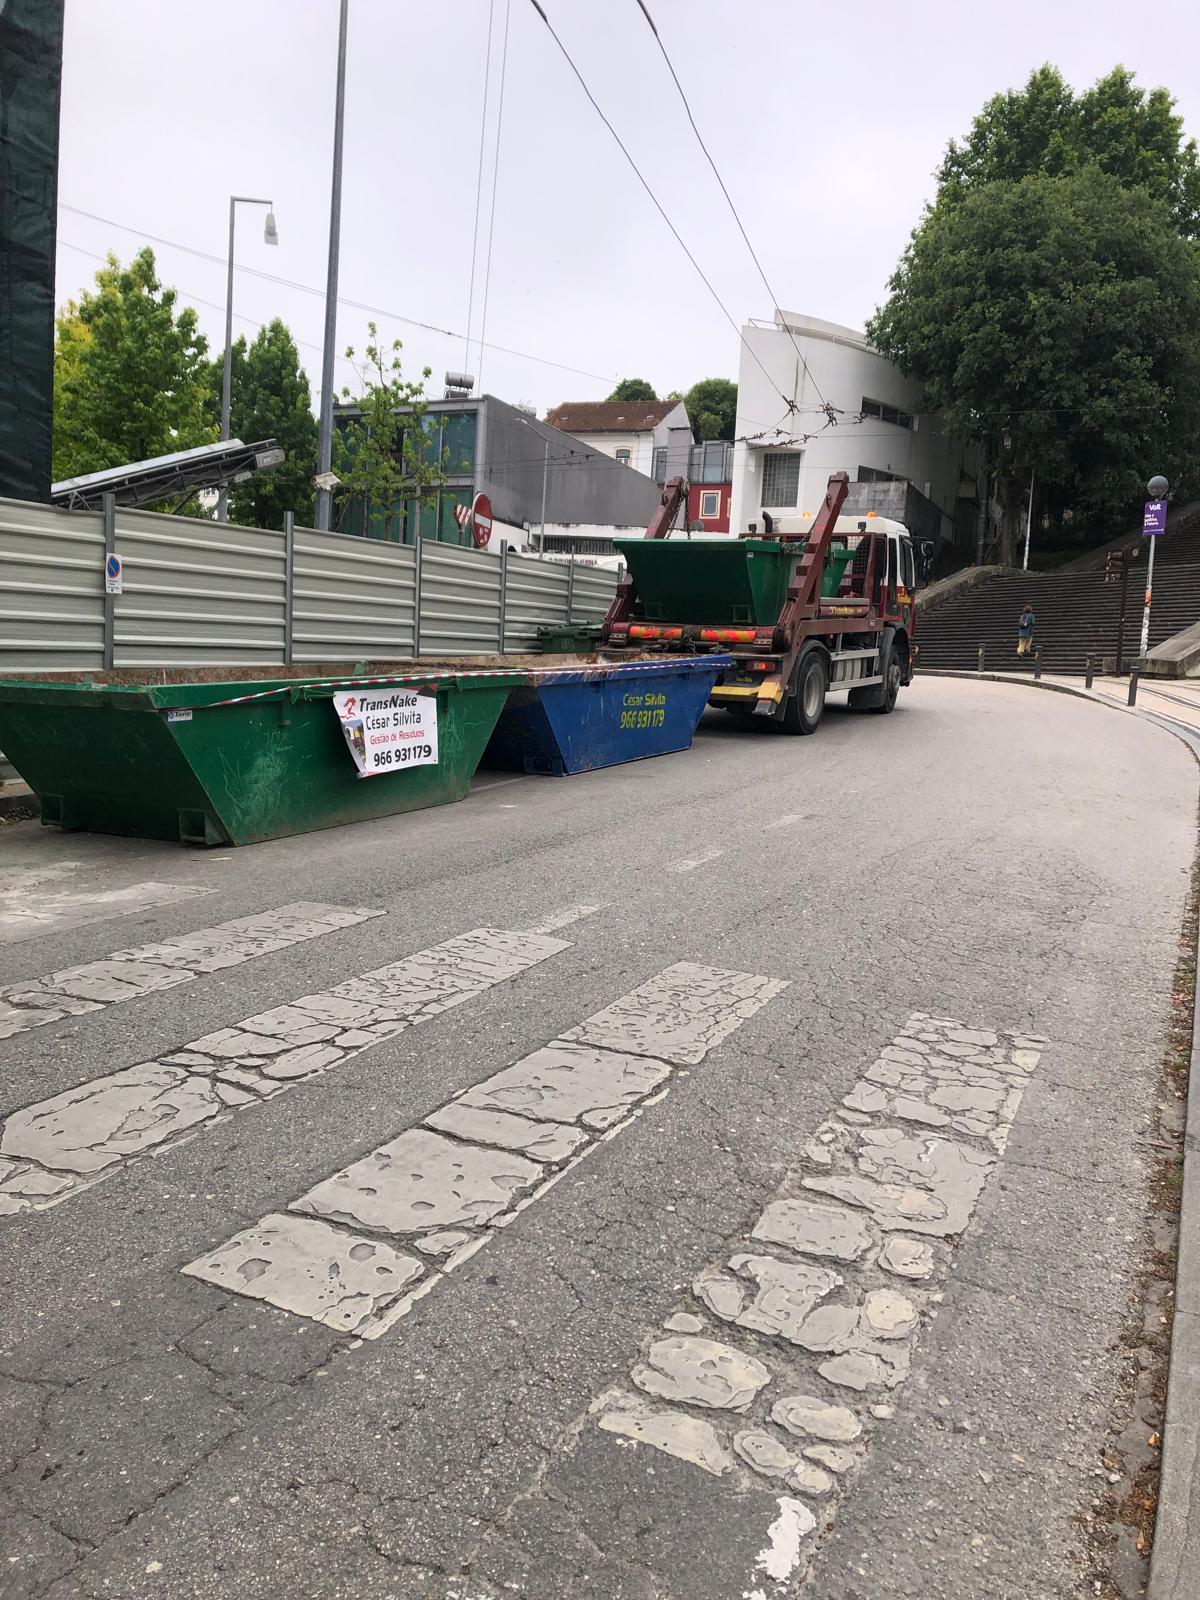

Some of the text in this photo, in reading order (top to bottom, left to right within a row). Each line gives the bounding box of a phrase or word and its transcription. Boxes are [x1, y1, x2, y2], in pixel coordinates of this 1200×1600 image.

[359, 695, 417, 712] TransNake
[393, 709, 421, 726] Silvita
[390, 731, 398, 742] de
[374, 751, 392, 766] 966
